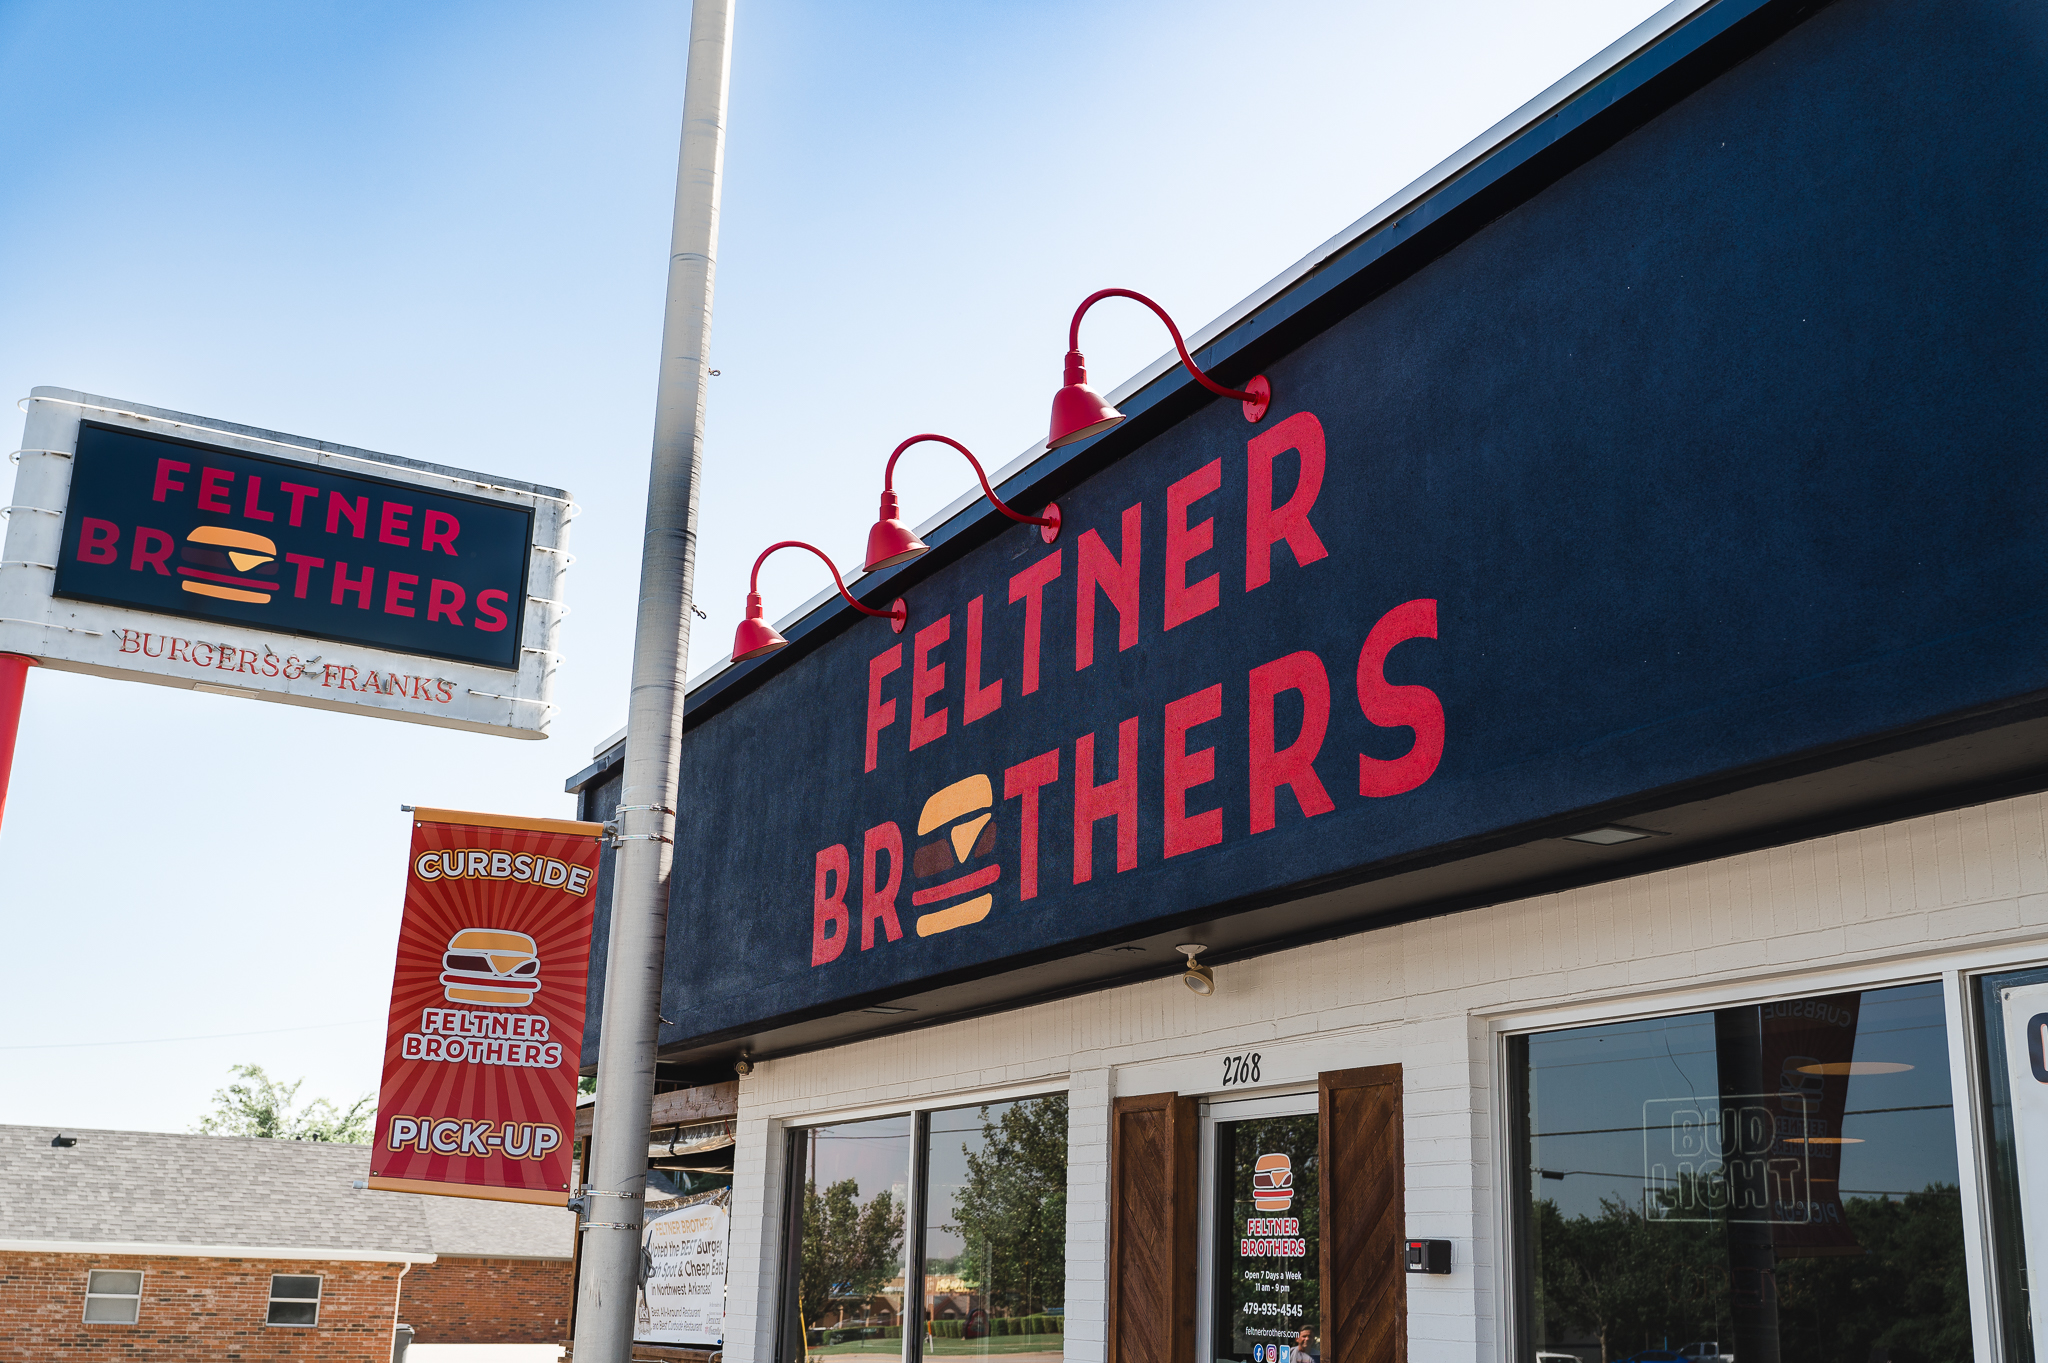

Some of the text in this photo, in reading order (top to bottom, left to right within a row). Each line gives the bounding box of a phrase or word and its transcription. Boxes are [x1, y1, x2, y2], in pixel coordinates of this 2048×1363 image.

[152, 458, 461, 557] FELTNER
[76, 516, 509, 632] BRTHERS
[865, 411, 1329, 773] FELTNER
[321, 663, 455, 704] FRANKS
[811, 598, 1446, 967] BRTHERS
[416, 850, 593, 895] CURBSIDE
[423, 1009, 548, 1040] FELTNER
[404, 1035, 561, 1067] BROTHERS
[1223, 1052, 1261, 1086] 2768
[389, 1117, 560, 1159] PICK-UP
[1671, 1106, 1776, 1157] BUD
[1652, 1158, 1800, 1210] LIGHT
[655, 1217, 715, 1236] FELTNER BROTHERS
[1247, 1217, 1299, 1236] FELTNER
[669, 1240, 680, 1257] the
[680, 1239, 697, 1256] BEST
[1241, 1238, 1305, 1257] BROTHERS
[678, 1261, 683, 1277] &
[685, 1260, 710, 1279] Cheap
[711, 1258, 724, 1275] Eats
[1245, 1270, 1259, 1280] Open
[1261, 1271, 1265, 1280] 7
[1266, 1271, 1279, 1281] Days
[1285, 1271, 1302, 1280] Week
[657, 1282, 687, 1296] Northwest
[1255, 1283, 1260, 1292] 11
[1261, 1284, 1270, 1292] am
[1275, 1284, 1279, 1292] 9
[1280, 1285, 1290, 1293] pm
[1243, 1302, 1303, 1317] 479-935-4545
[1245, 1326, 1300, 1339] feltnerbrothers.com
